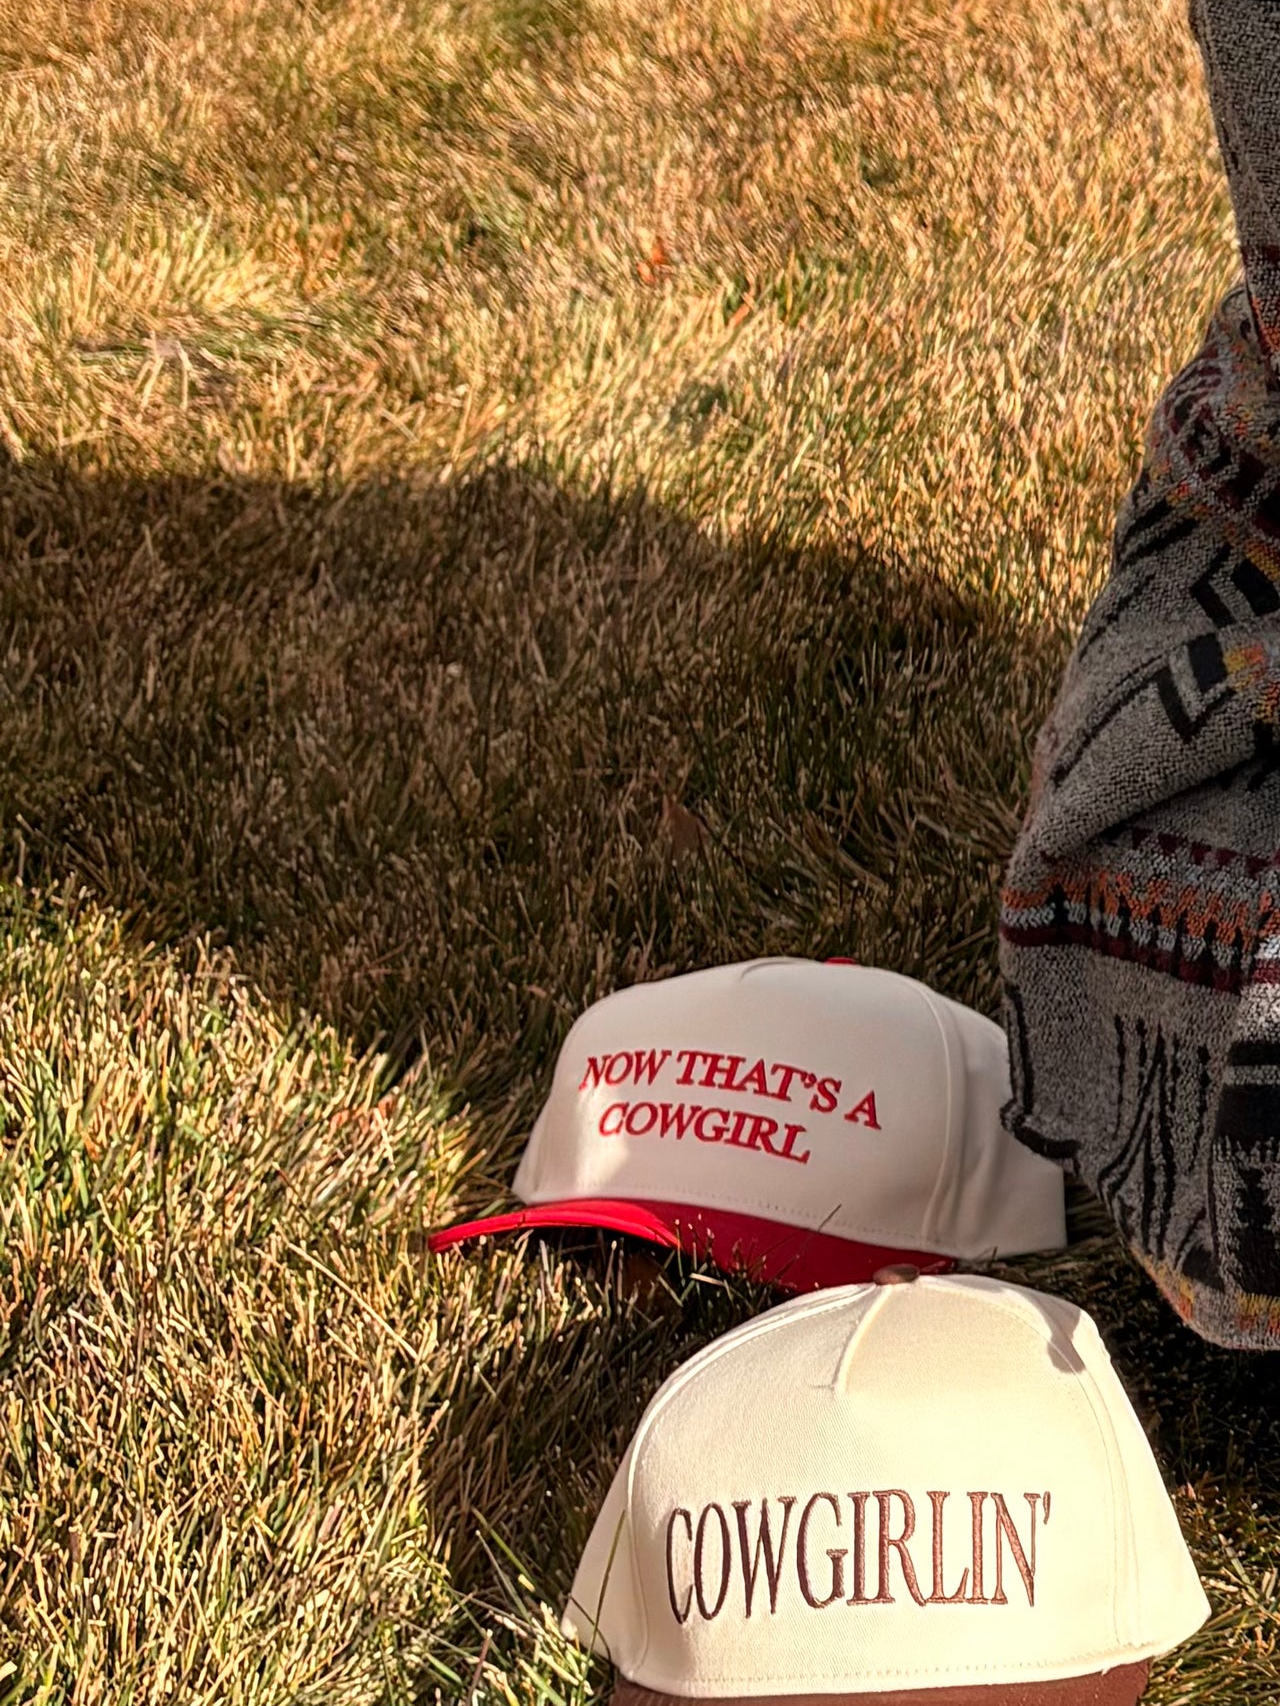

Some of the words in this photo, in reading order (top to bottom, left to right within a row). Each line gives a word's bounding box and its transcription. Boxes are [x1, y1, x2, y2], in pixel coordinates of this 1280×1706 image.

[578, 1048, 672, 1091] NOW
[676, 1050, 843, 1113] THAT'S
[844, 1090, 882, 1131] A
[599, 1101, 811, 1164] COWGIRL
[666, 1488, 1051, 1624] COWGIRLIN'
